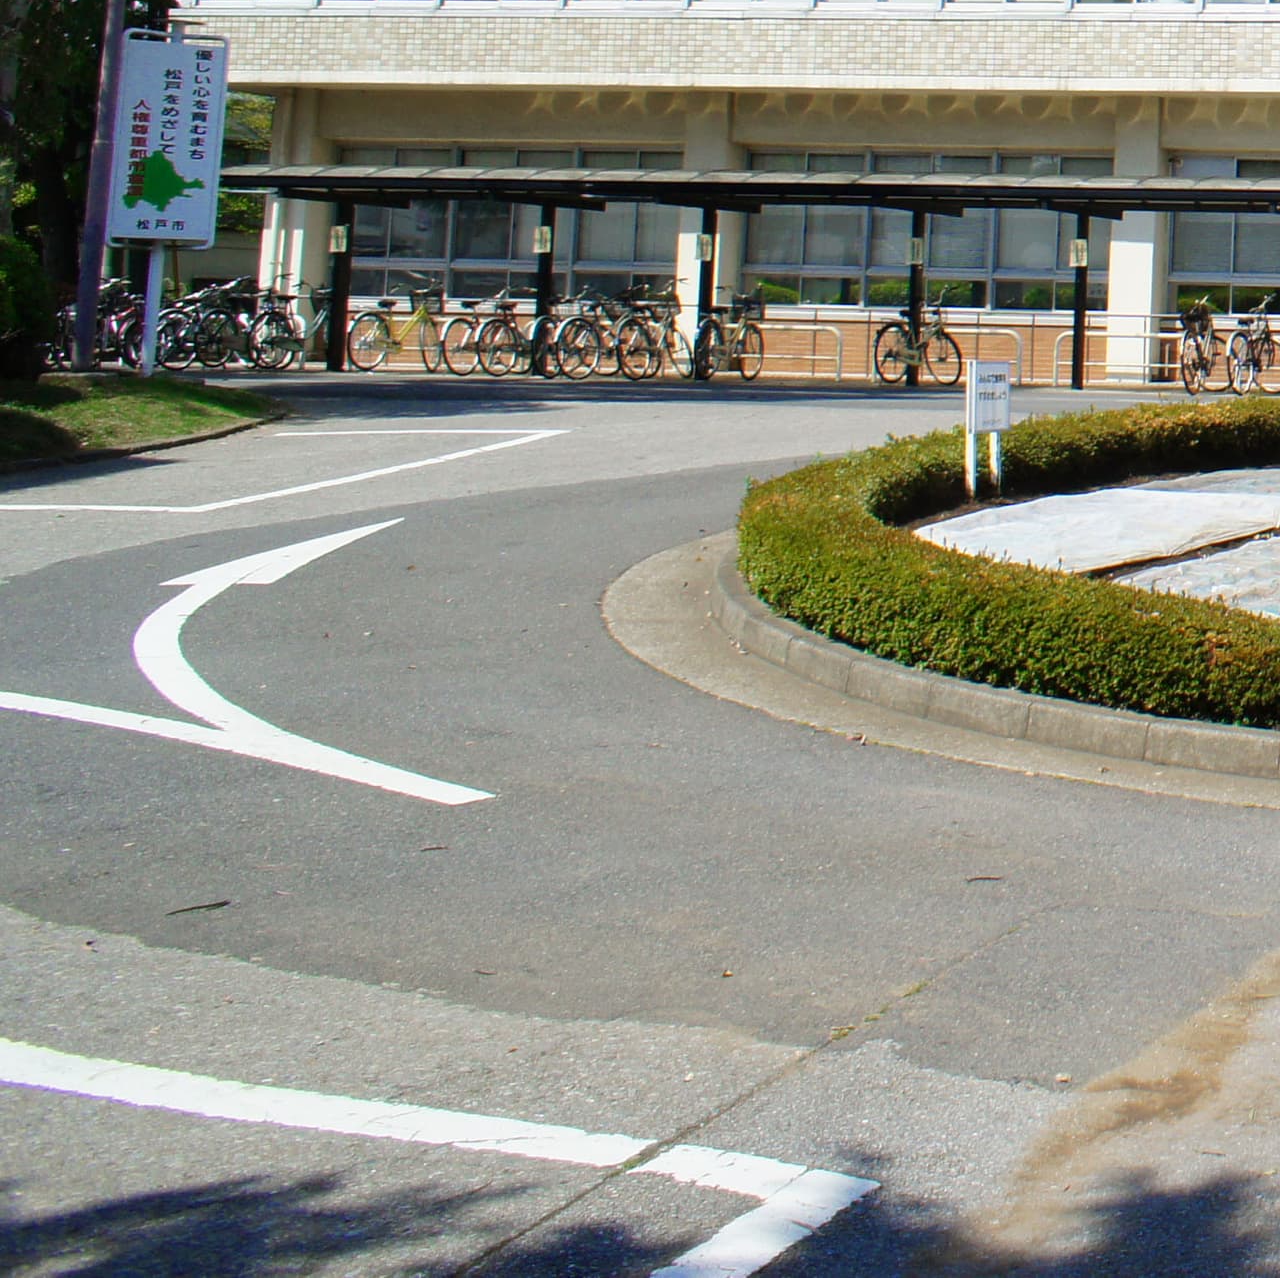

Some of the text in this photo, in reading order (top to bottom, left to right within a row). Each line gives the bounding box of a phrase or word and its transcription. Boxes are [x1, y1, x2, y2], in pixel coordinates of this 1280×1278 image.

[160, 68, 183, 154] 松戸をめざして
[188, 49, 213, 160] 優しい心を育むまち
[137, 219, 185, 231] 松戸市
